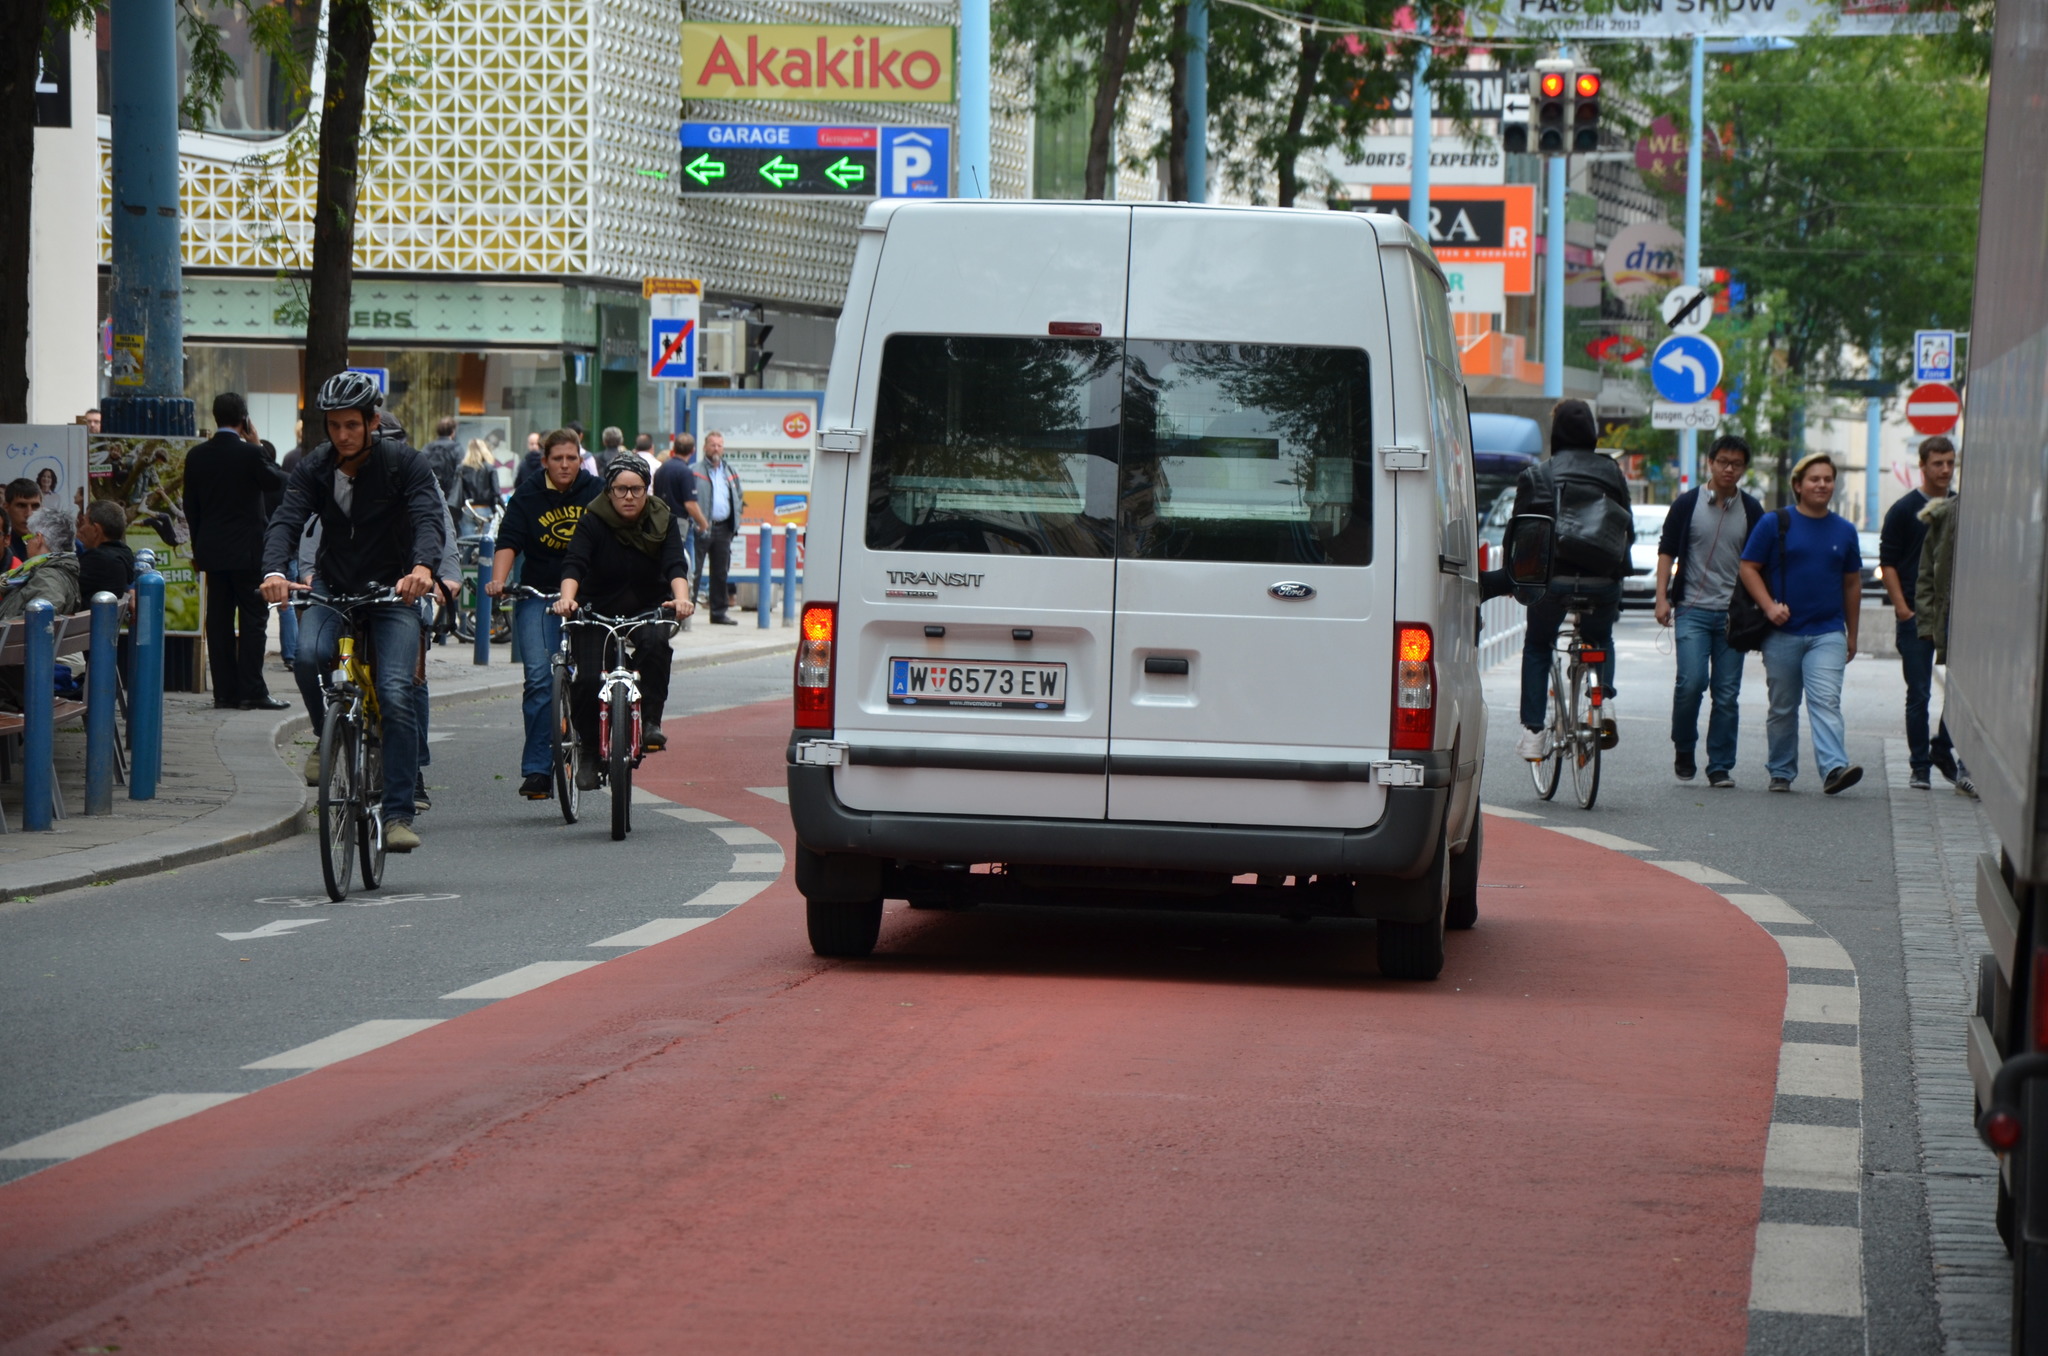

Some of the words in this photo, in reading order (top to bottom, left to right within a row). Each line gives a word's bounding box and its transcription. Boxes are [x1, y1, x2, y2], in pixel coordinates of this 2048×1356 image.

[1609, 19, 1640, 30] 2013
[697, 35, 941, 89] Akakiko
[1392, 78, 1503, 111] STRN
[708, 127, 790, 144] GARAGE
[1345, 153, 1406, 167] SPORTS
[1430, 152, 1498, 167] EXPERTS
[892, 146, 932, 195] P
[1352, 206, 1481, 242] RA
[1625, 241, 1675, 270] dm
[273, 308, 412, 328] PAERS
[1674, 296, 1700, 325] 20
[1654, 411, 1683, 423] ausgen.
[761, 451, 809, 460] Reimer
[886, 570, 985, 587] TRANSIT
[1278, 584, 1306, 597] Ford
[896, 682, 904, 690] A
[910, 666, 928, 691] W
[949, 668, 1014, 695] 6573
[1021, 670, 1058, 696] EW
